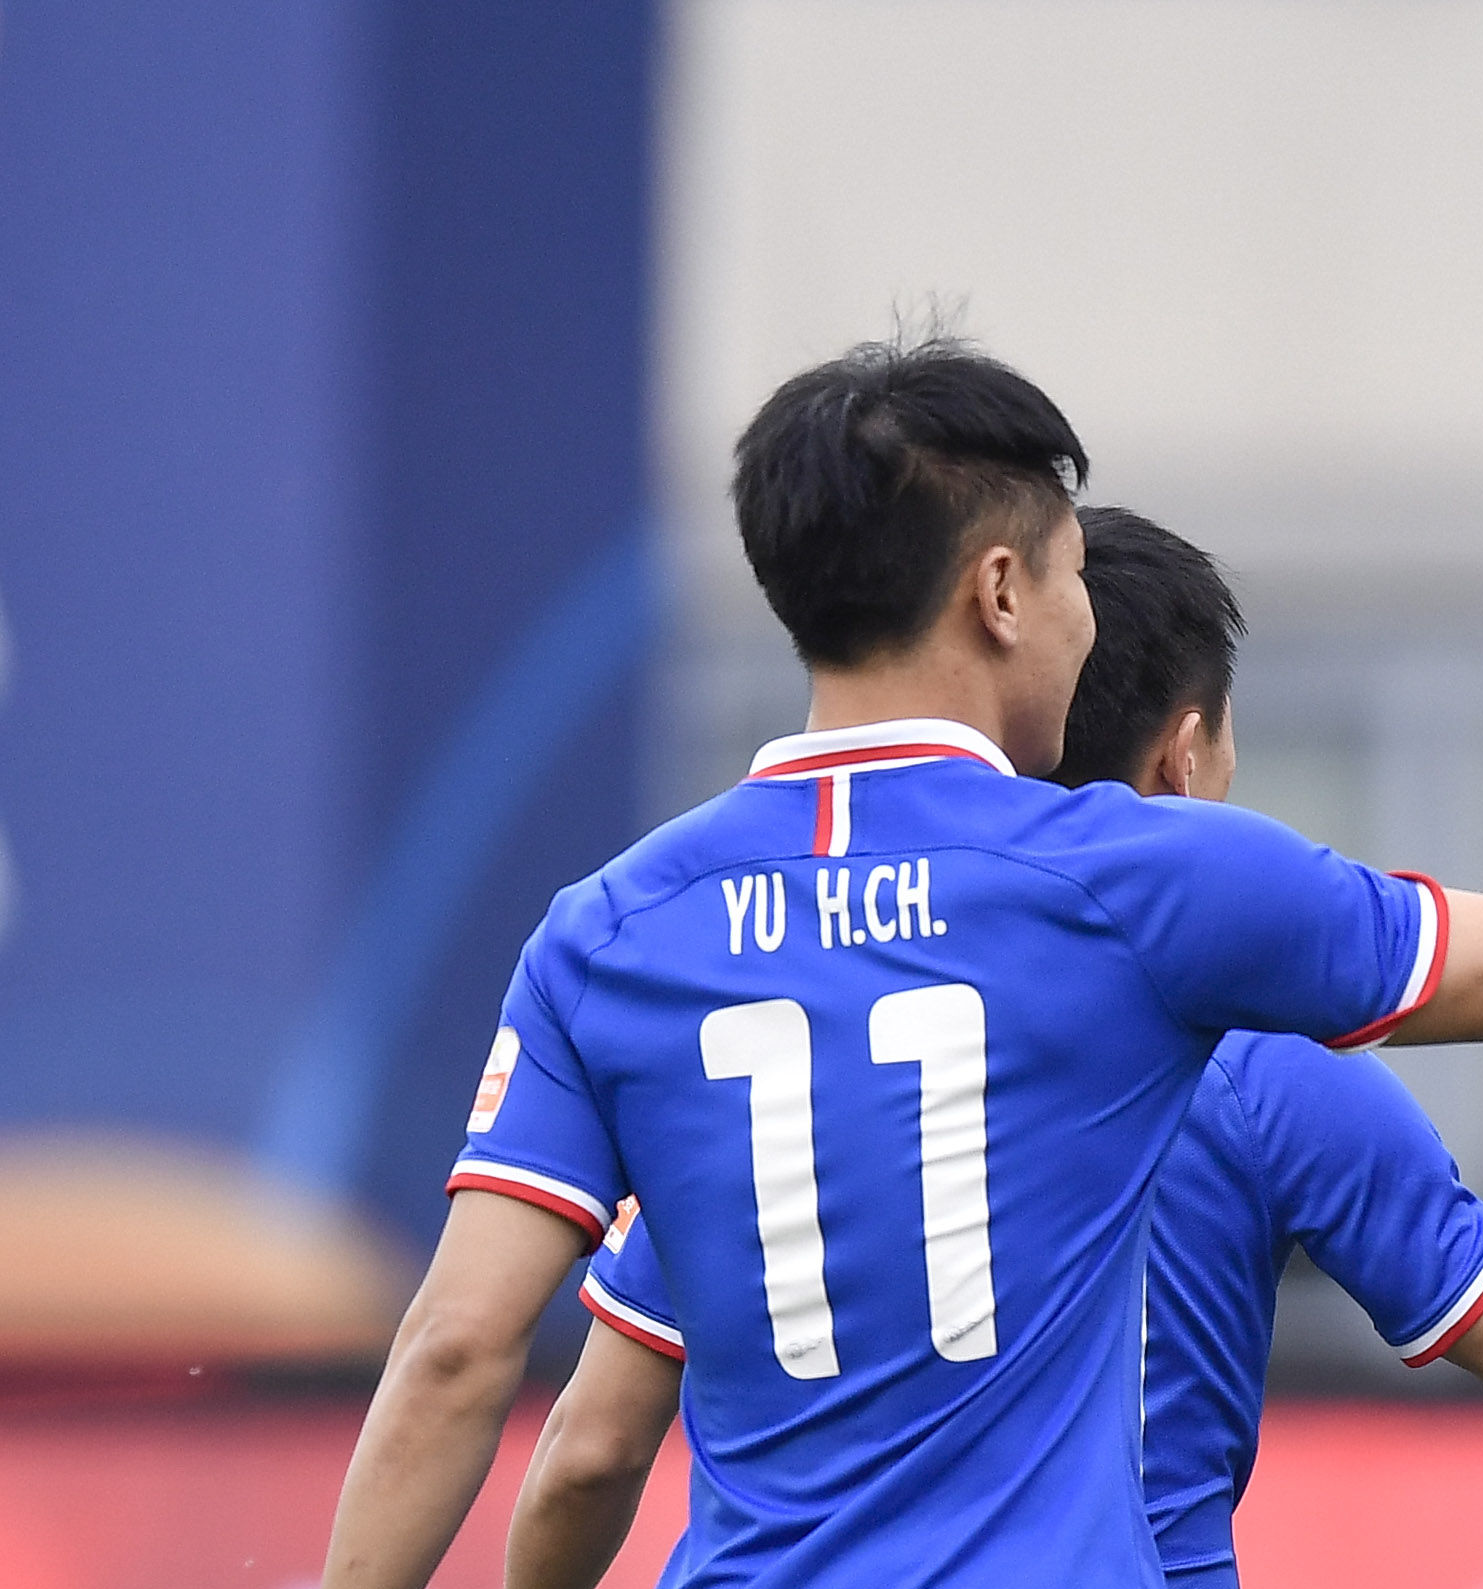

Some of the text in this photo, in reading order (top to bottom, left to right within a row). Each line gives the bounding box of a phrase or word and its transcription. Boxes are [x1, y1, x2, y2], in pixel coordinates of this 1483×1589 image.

[721, 857, 948, 955] YU H.CH.
[699, 982, 998, 1380] 11
